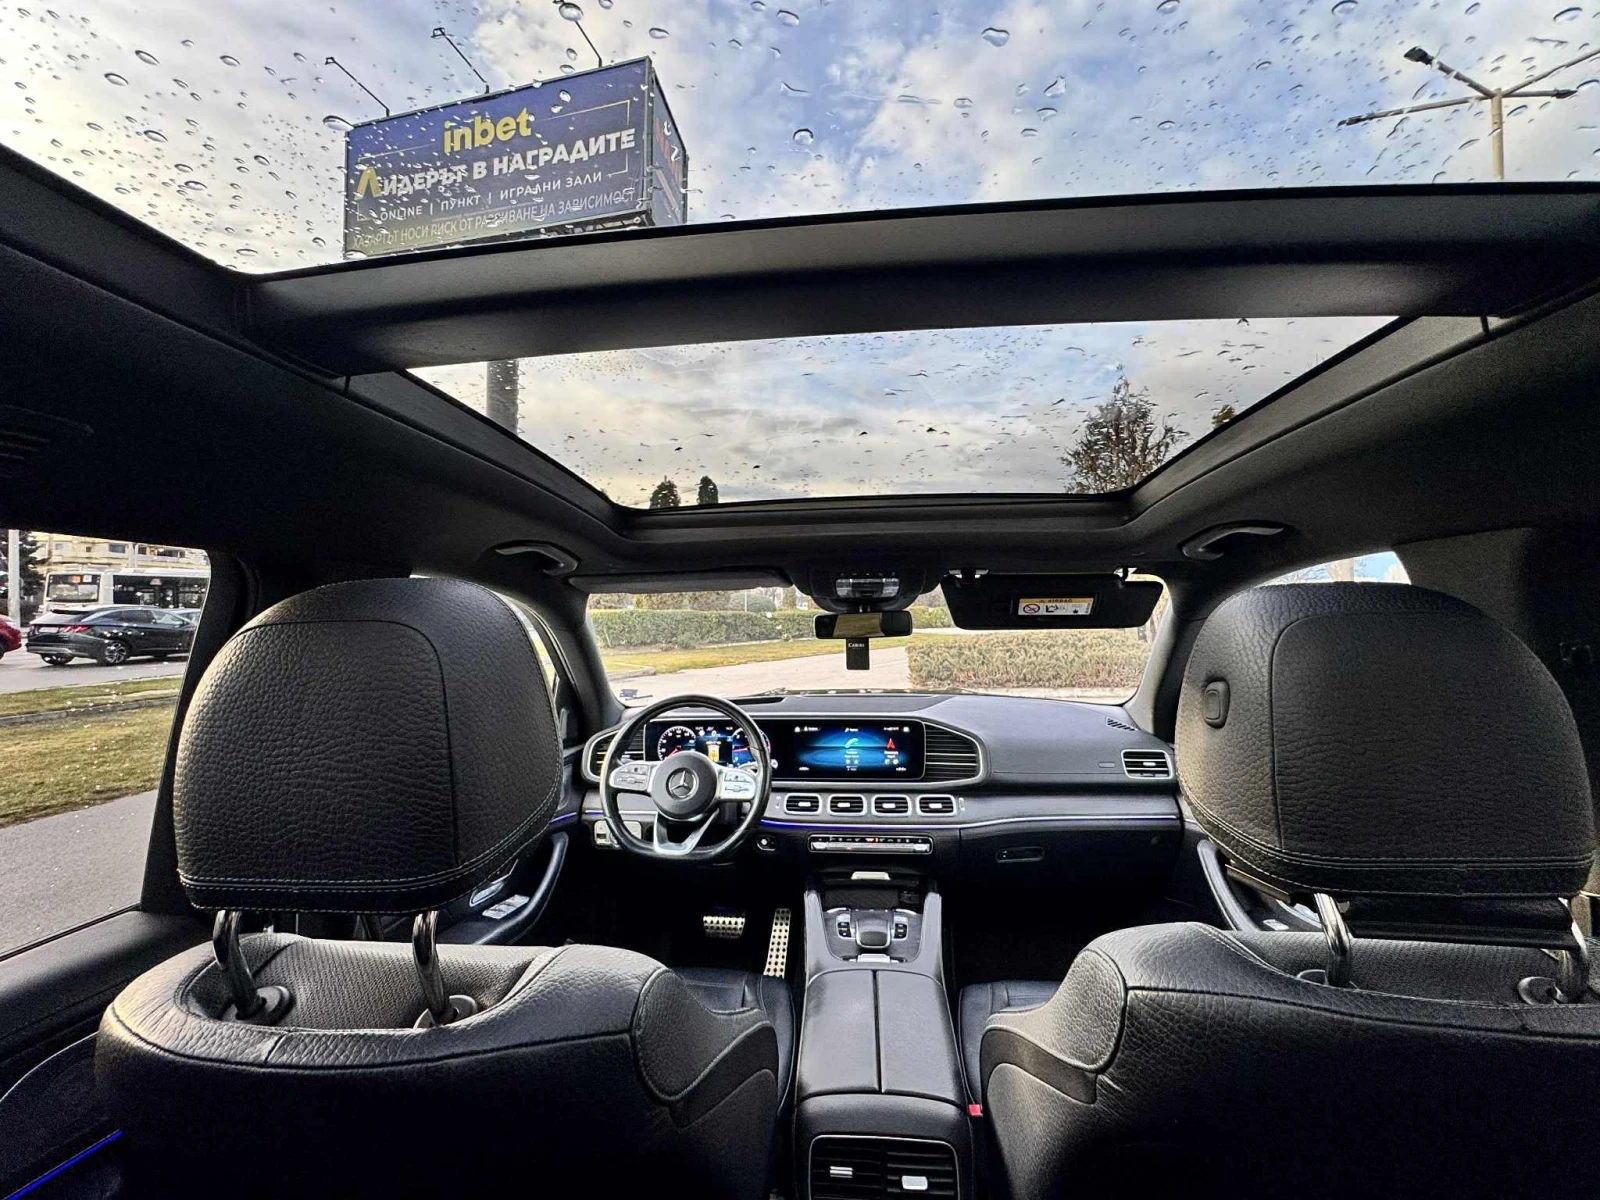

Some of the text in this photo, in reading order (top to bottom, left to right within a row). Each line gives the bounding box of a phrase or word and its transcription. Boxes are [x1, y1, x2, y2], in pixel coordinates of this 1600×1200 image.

[444, 107, 532, 155] inbet
[353, 164, 468, 200] ЛИДЕРЪТ
[473, 161, 487, 180] В
[493, 128, 635, 176] НАГРАДИТЕ
[380, 171, 602, 221] ONLINE ПУНКТ ИГРАЛНИ ЗАЛИ
[400, 226, 429, 242] НОСИ
[459, 218, 474, 231] ОТ
[539, 204, 556, 218] НА
